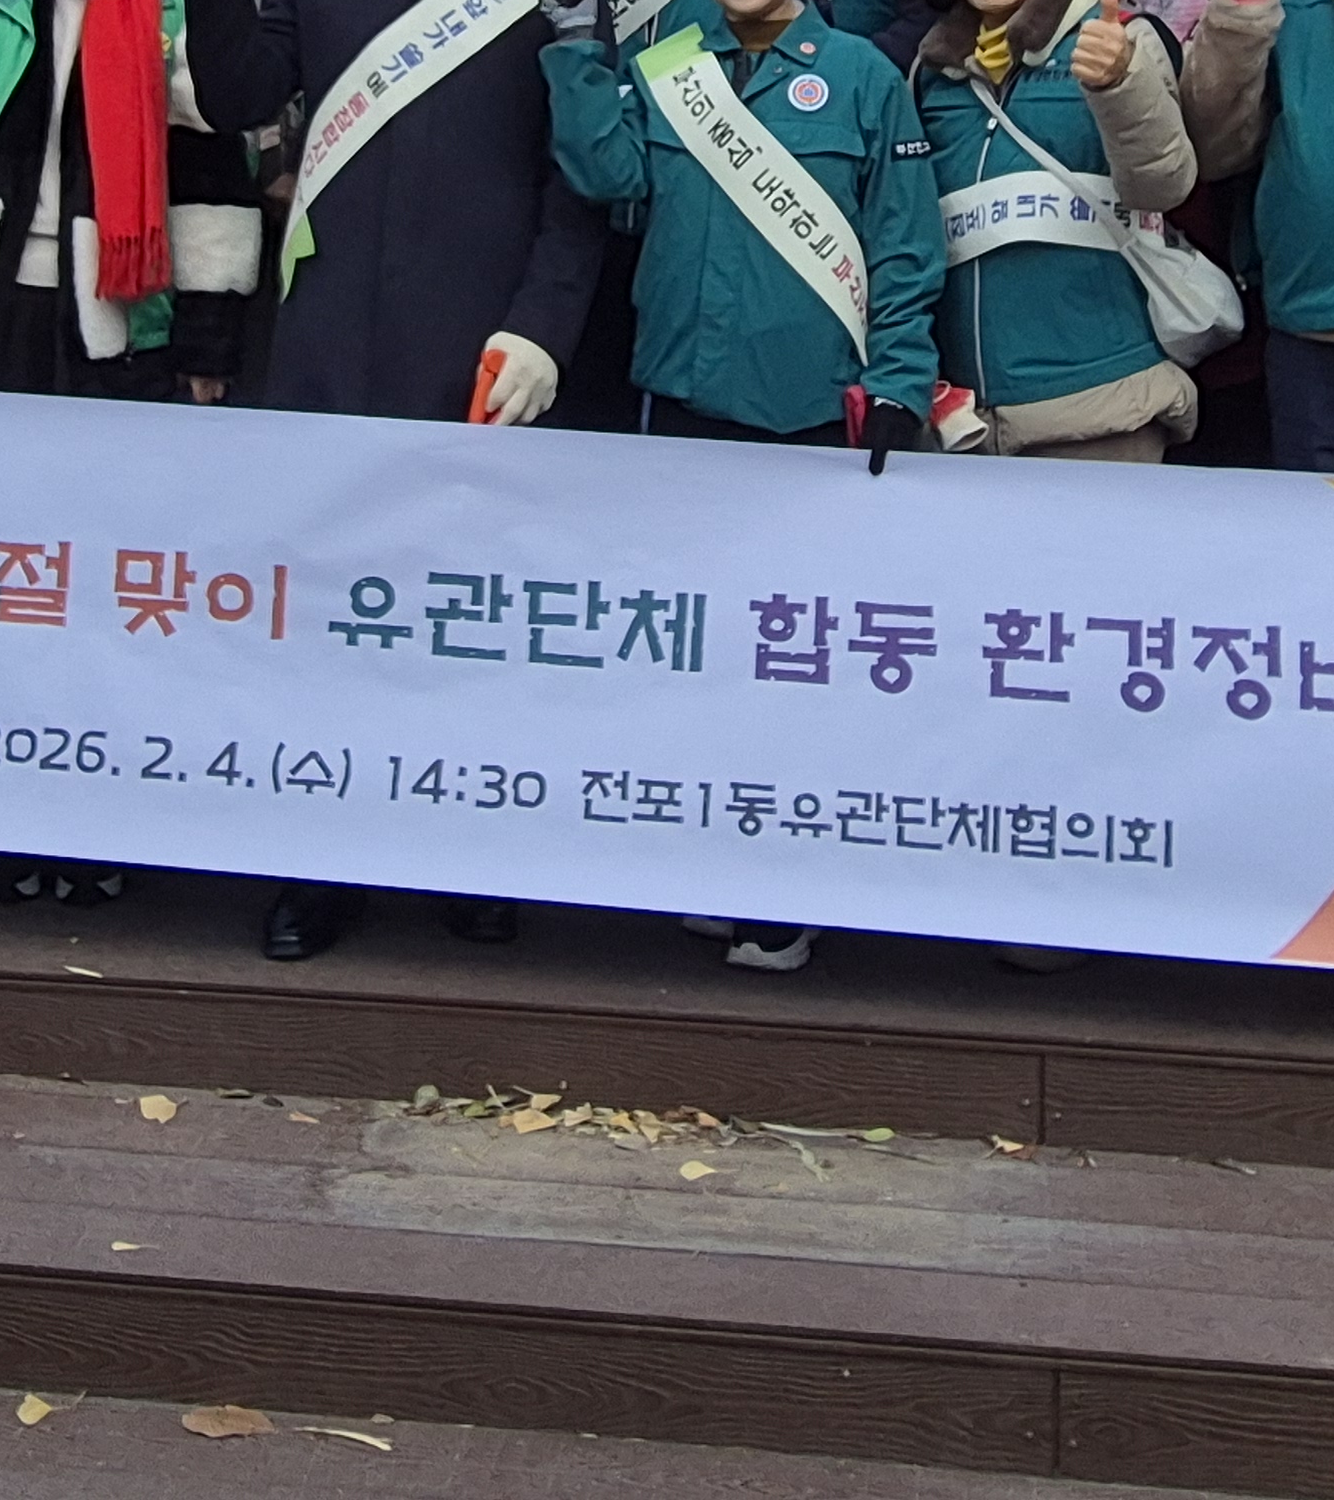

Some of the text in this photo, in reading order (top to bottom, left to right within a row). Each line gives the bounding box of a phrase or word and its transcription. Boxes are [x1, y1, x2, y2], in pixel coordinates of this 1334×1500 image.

[365, 41, 425, 101] 쓸기에
[422, 11, 467, 53] 내가
[300, 90, 369, 180] 동참합시다
[672, 65, 716, 125] 부산의
[707, 115, 764, 172] 중심,
[751, 167, 839, 262] 도약하는
[990, 201, 1009, 225] 앞
[1017, 192, 1060, 219] 내가
[113, 548, 289, 640] 맞이
[327, 571, 708, 673] 유관단체
[749, 592, 938, 695] 합동
[388, 755, 548, 809] 14:30
[580, 769, 1174, 868] 전포1동유관단체협의회
